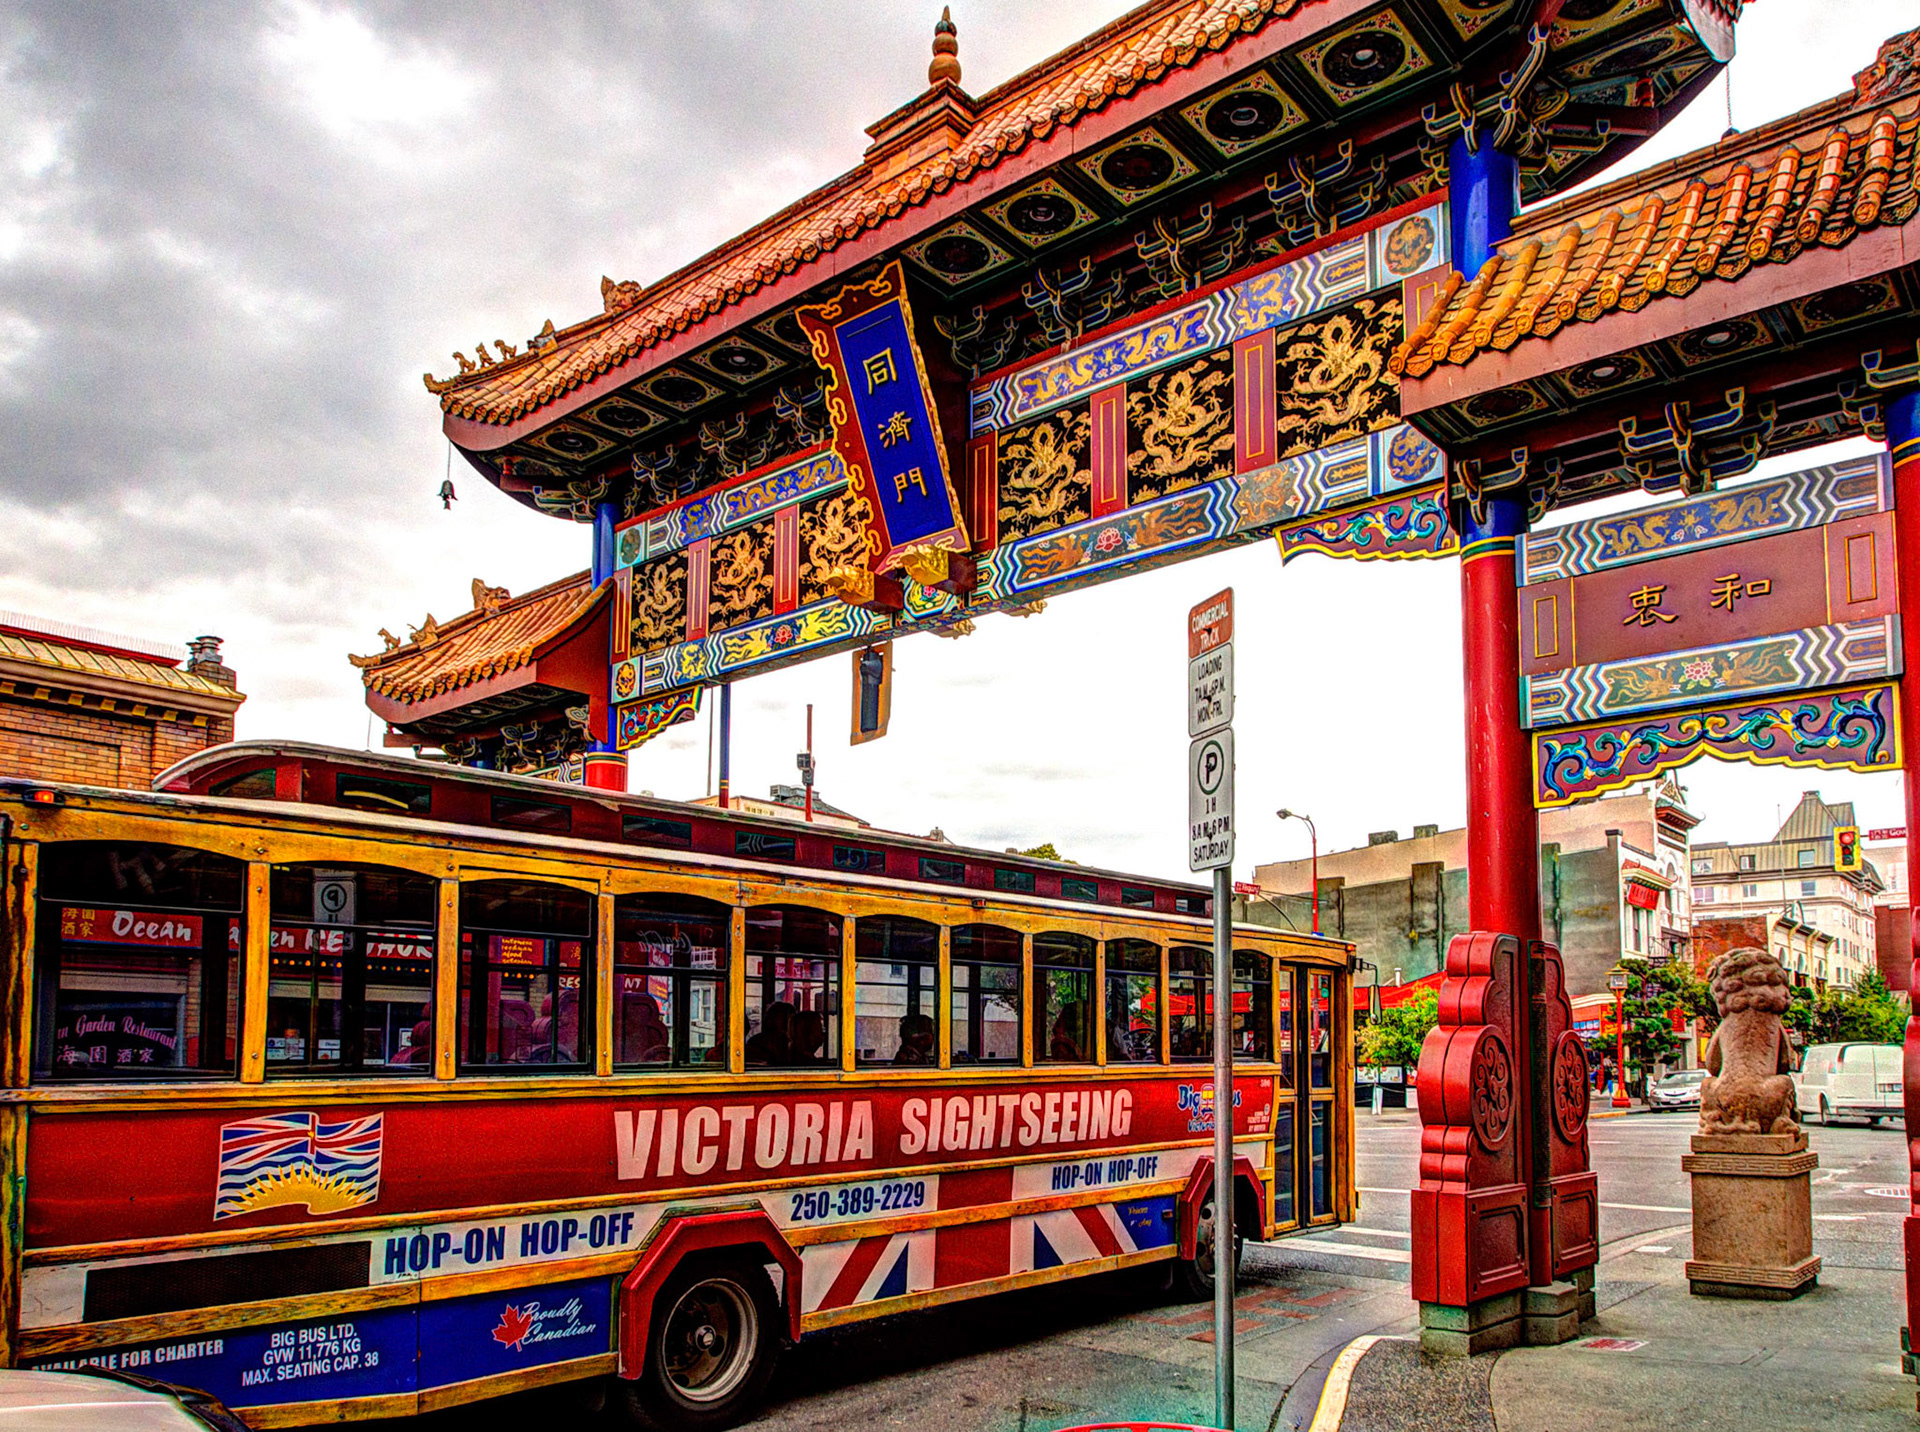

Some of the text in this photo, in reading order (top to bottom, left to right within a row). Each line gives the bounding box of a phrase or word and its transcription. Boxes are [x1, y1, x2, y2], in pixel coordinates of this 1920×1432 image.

[1191, 600, 1229, 634] COMMERCIAL
[1200, 626, 1220, 651] TRUCK
[1197, 654, 1222, 681] LOADING
[1194, 840, 1229, 863] SATURDAY
[111, 910, 192, 942] Ocean
[76, 1014, 116, 1038] Garden
[1177, 1084, 1201, 1117] Big
[614, 1089, 1133, 1180] VICTORIA SIGHTSEEING
[1052, 1156, 1158, 1190] HOP-ON HOP-OFF
[791, 1181, 925, 1221] 250-389-2229
[384, 1212, 635, 1276] HOP-ON HOP-OFF
[519, 1297, 583, 1324] Proudly
[270, 1322, 358, 1348] BIG BUS LTD.
[521, 1318, 596, 1345] Canadian
[120, 1349, 151, 1369] FOR
[155, 1338, 224, 1364] CHARTER
[262, 1337, 361, 1366] GVW 11,776 KG
[241, 1351, 379, 1387] MAX. SEATING CAP. 38
